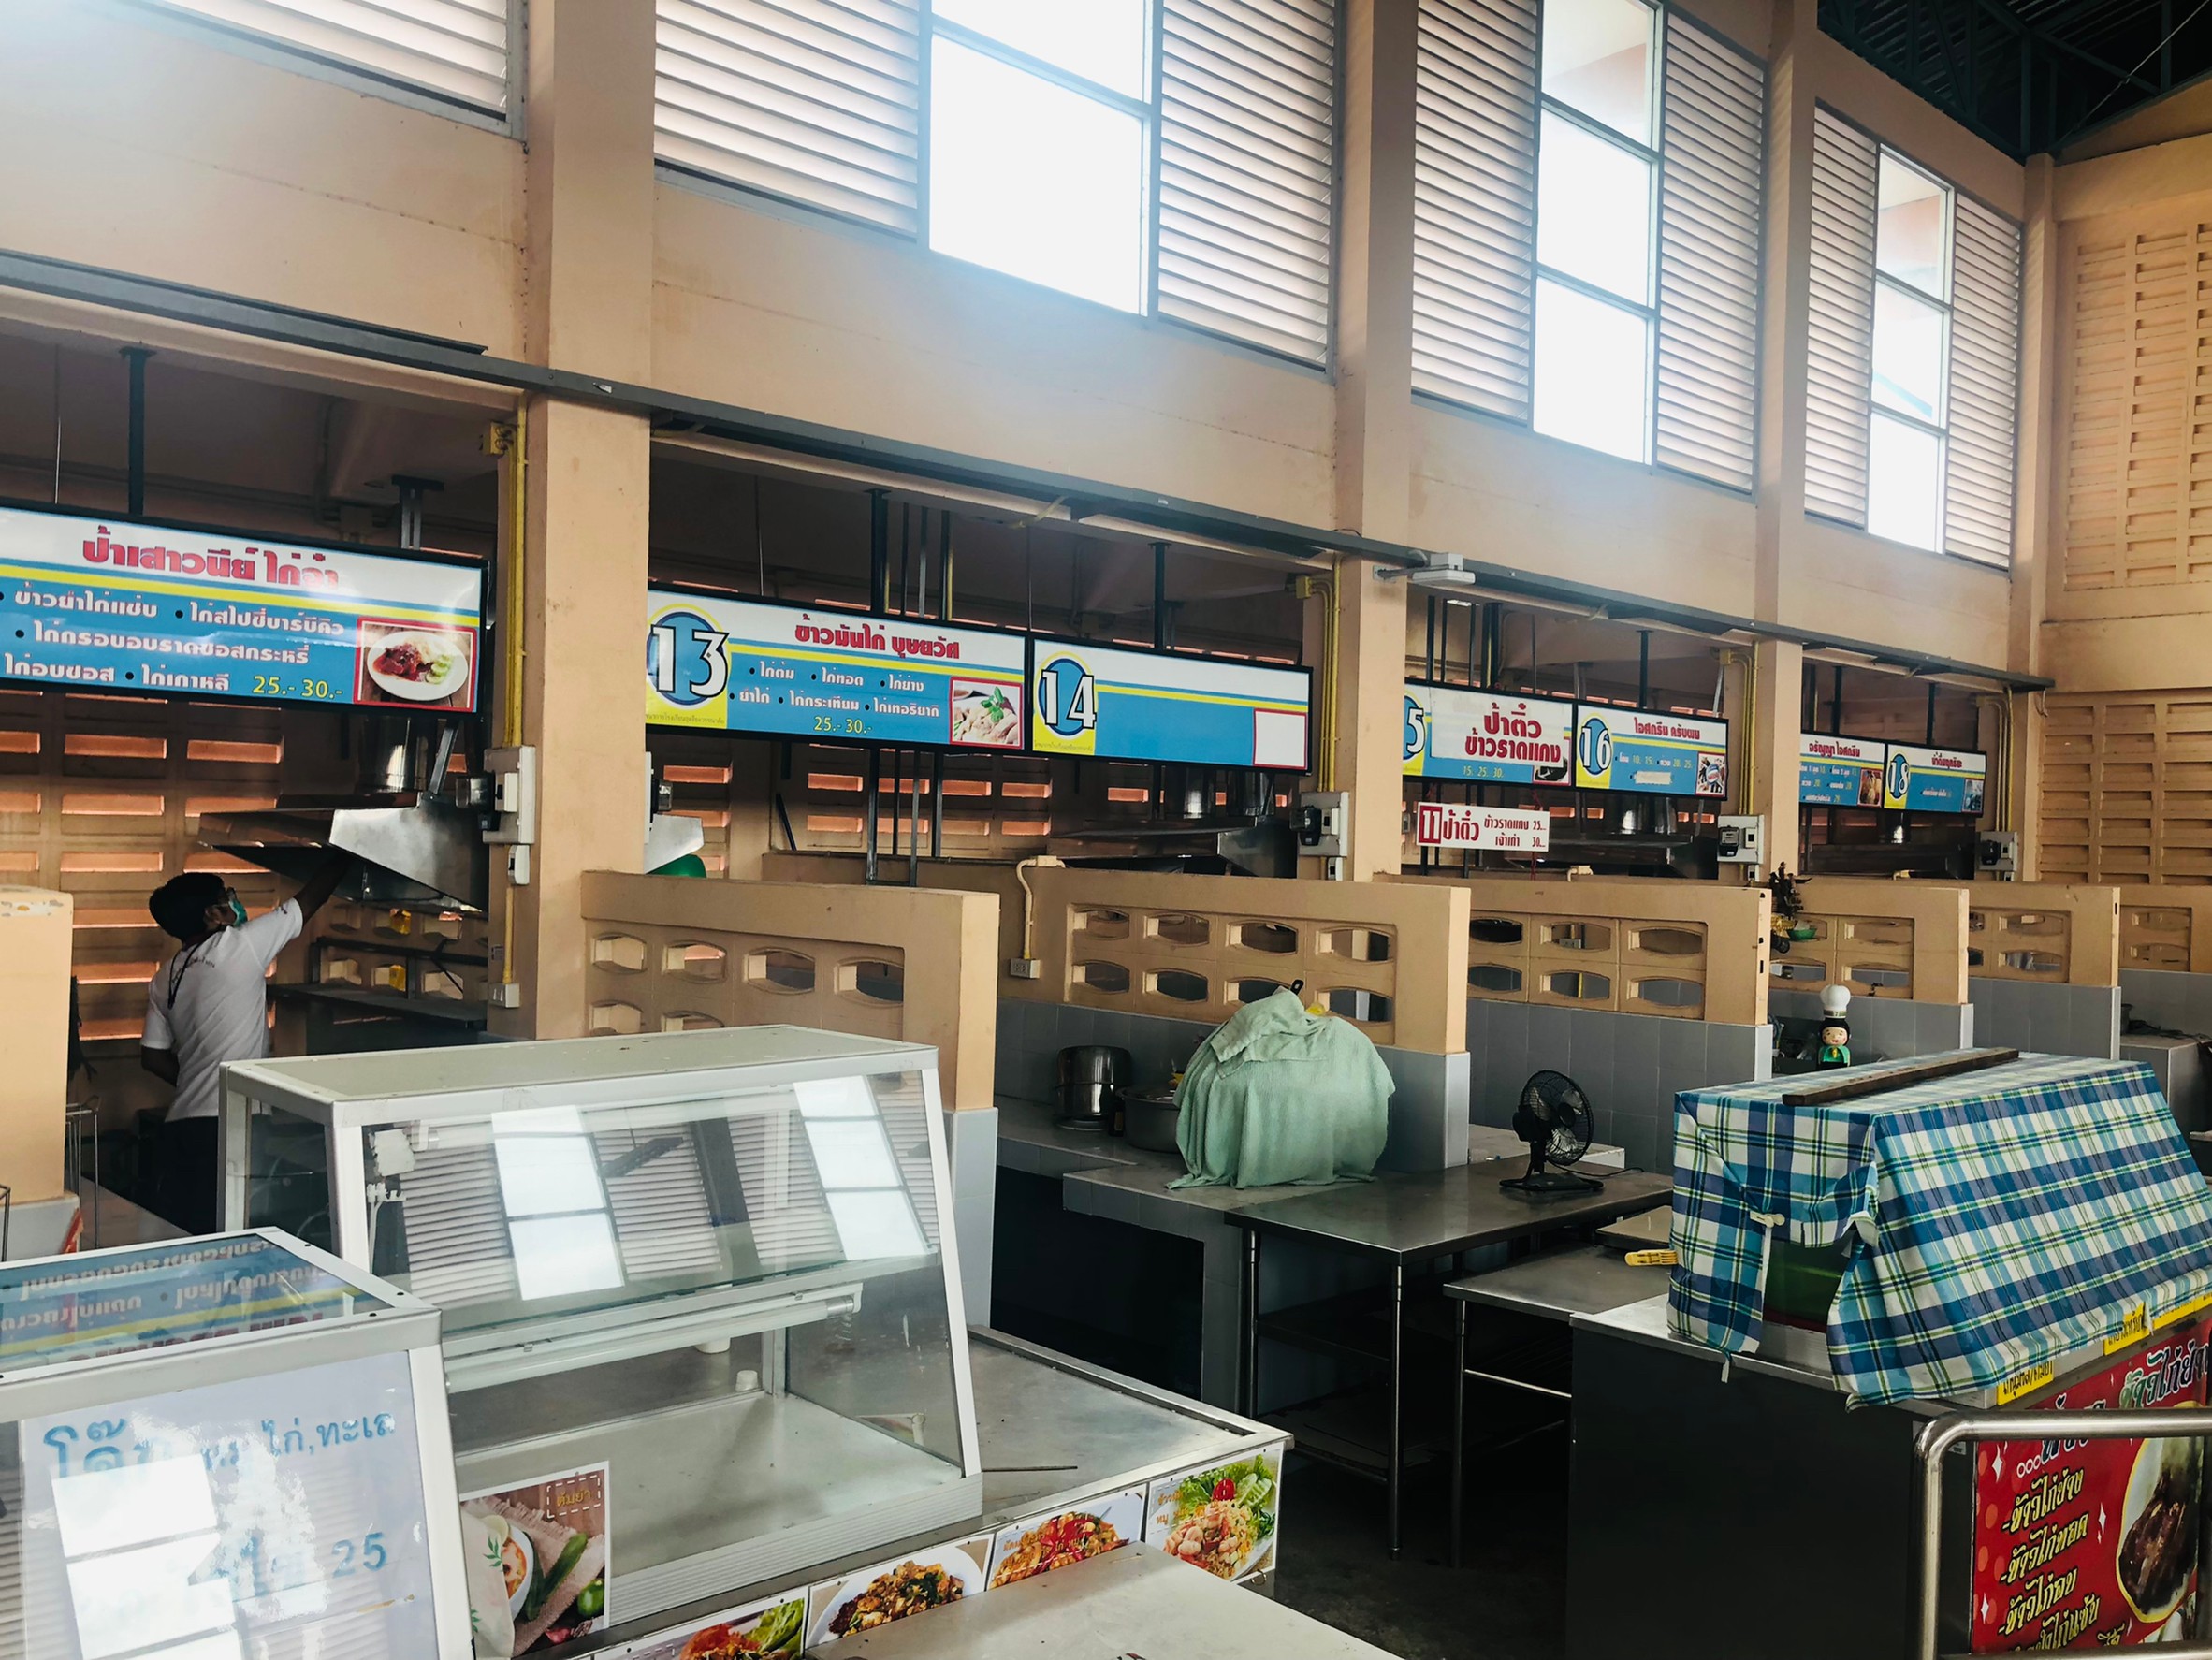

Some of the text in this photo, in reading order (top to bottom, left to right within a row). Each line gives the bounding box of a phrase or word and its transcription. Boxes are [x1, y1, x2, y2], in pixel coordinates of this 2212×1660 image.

[794, 613, 886, 650] ข้าวมันไก่
[5, 653, 115, 682] ไก่อบซอส
[650, 623, 730, 698] 13
[760, 660, 794, 679] ไก่ต้ม
[141, 663, 229, 691] ไก่เกาหลี
[822, 666, 864, 686] ไก่ทอด
[889, 673, 924, 692] ไก่ย่าง
[739, 686, 770, 704] ยำไก่
[790, 690, 860, 711] ไก่กระเทียม
[1041, 669, 1097, 730] 14
[1405, 706, 1426, 754] 5
[1464, 727, 1562, 763] ข้าวราดแกง
[1581, 726, 1612, 771] 16
[1890, 760, 1909, 795] 18
[1484, 814, 1529, 830] ข้าวราดแกง
